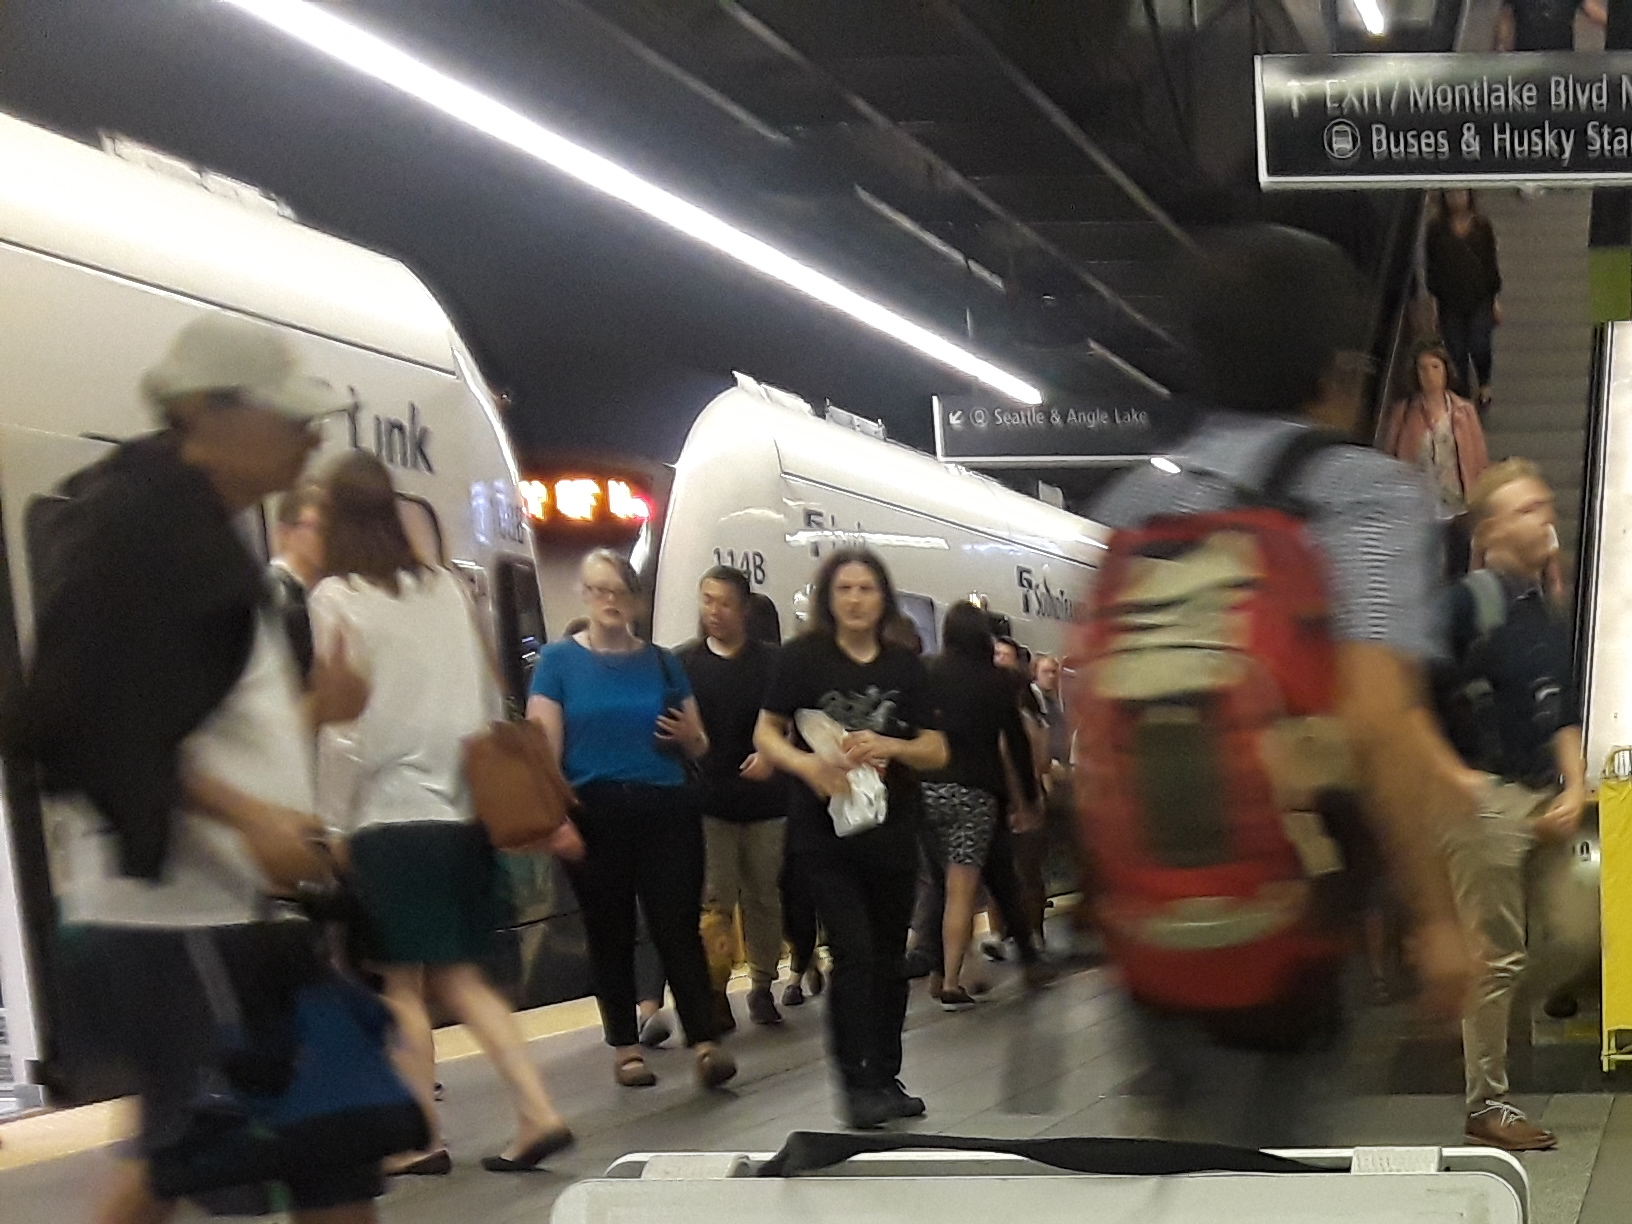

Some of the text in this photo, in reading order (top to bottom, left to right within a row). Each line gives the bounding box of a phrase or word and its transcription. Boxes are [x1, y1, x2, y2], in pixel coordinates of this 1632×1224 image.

[1408, 75, 1538, 113] Montlake
[1550, 73, 1608, 112] Blvd
[1371, 123, 1450, 160] Buses
[1460, 122, 1481, 160] &
[1492, 120, 1575, 167] Husky
[993, 407, 1044, 427] Seattle
[1067, 407, 1109, 428] Angle
